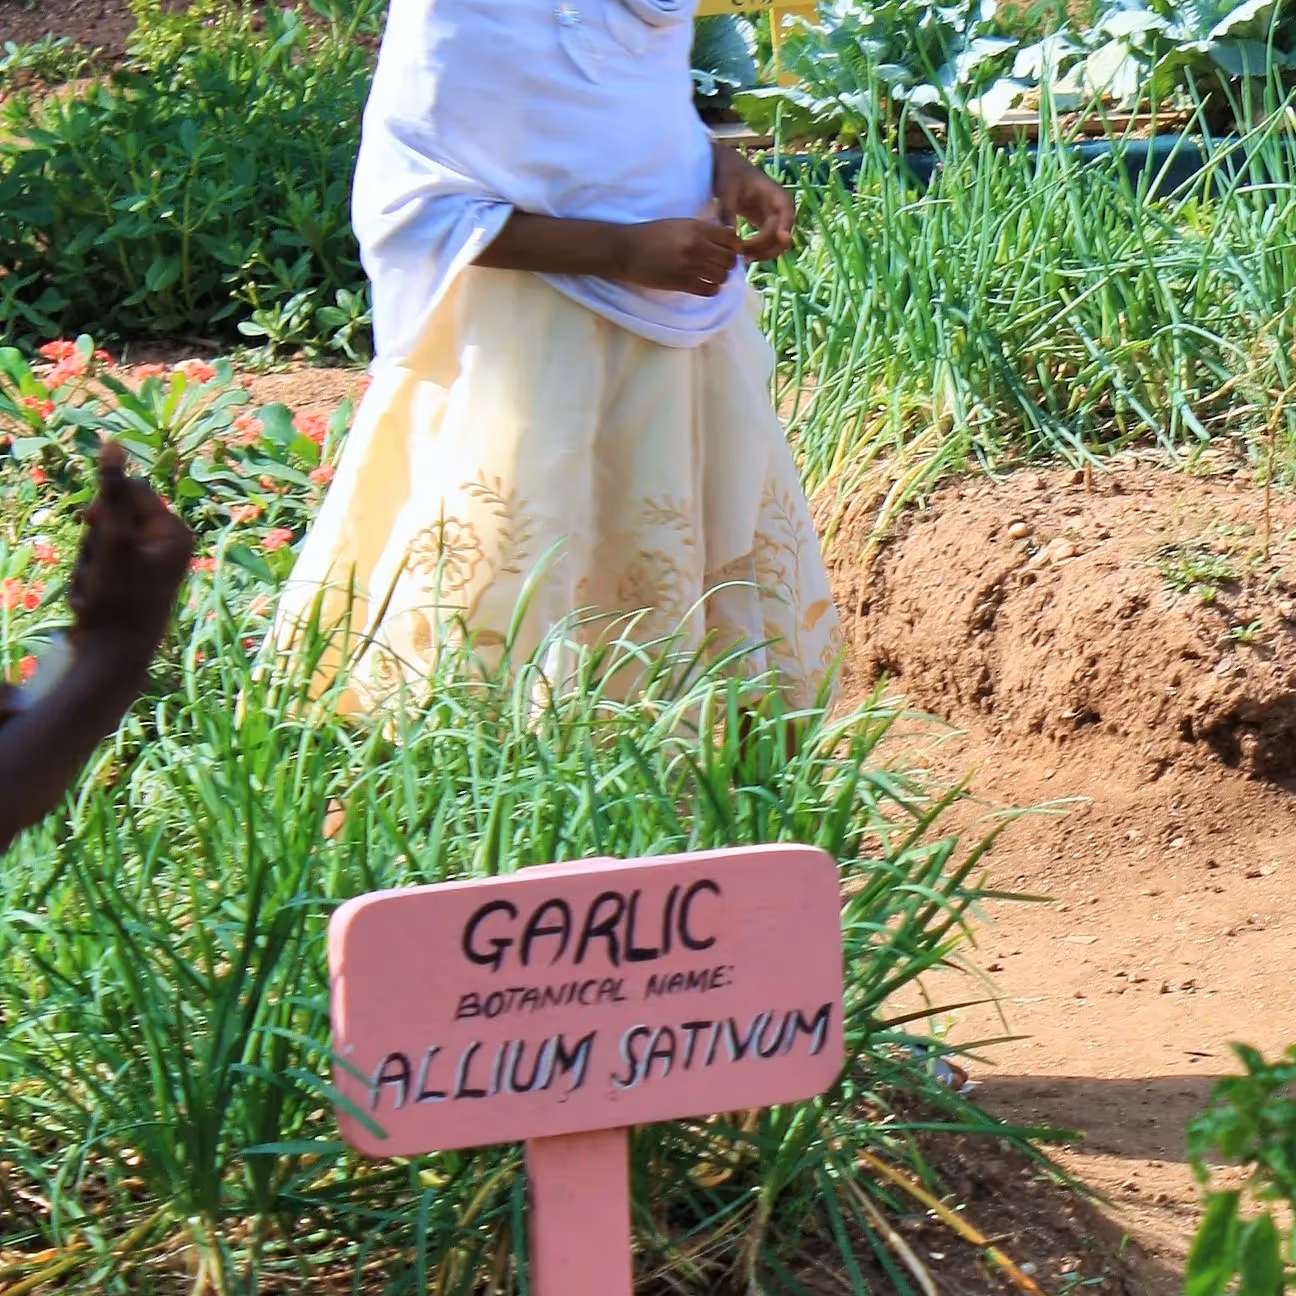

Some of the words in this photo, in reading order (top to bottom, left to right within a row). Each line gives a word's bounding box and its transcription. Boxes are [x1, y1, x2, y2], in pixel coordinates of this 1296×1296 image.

[462, 878, 722, 973] GARLIC
[454, 976, 627, 1021] BOTANICAL
[643, 964, 735, 1002] NAME:
[368, 1030, 598, 1111] ALLIUM
[611, 1003, 833, 1090] SATIVUM
